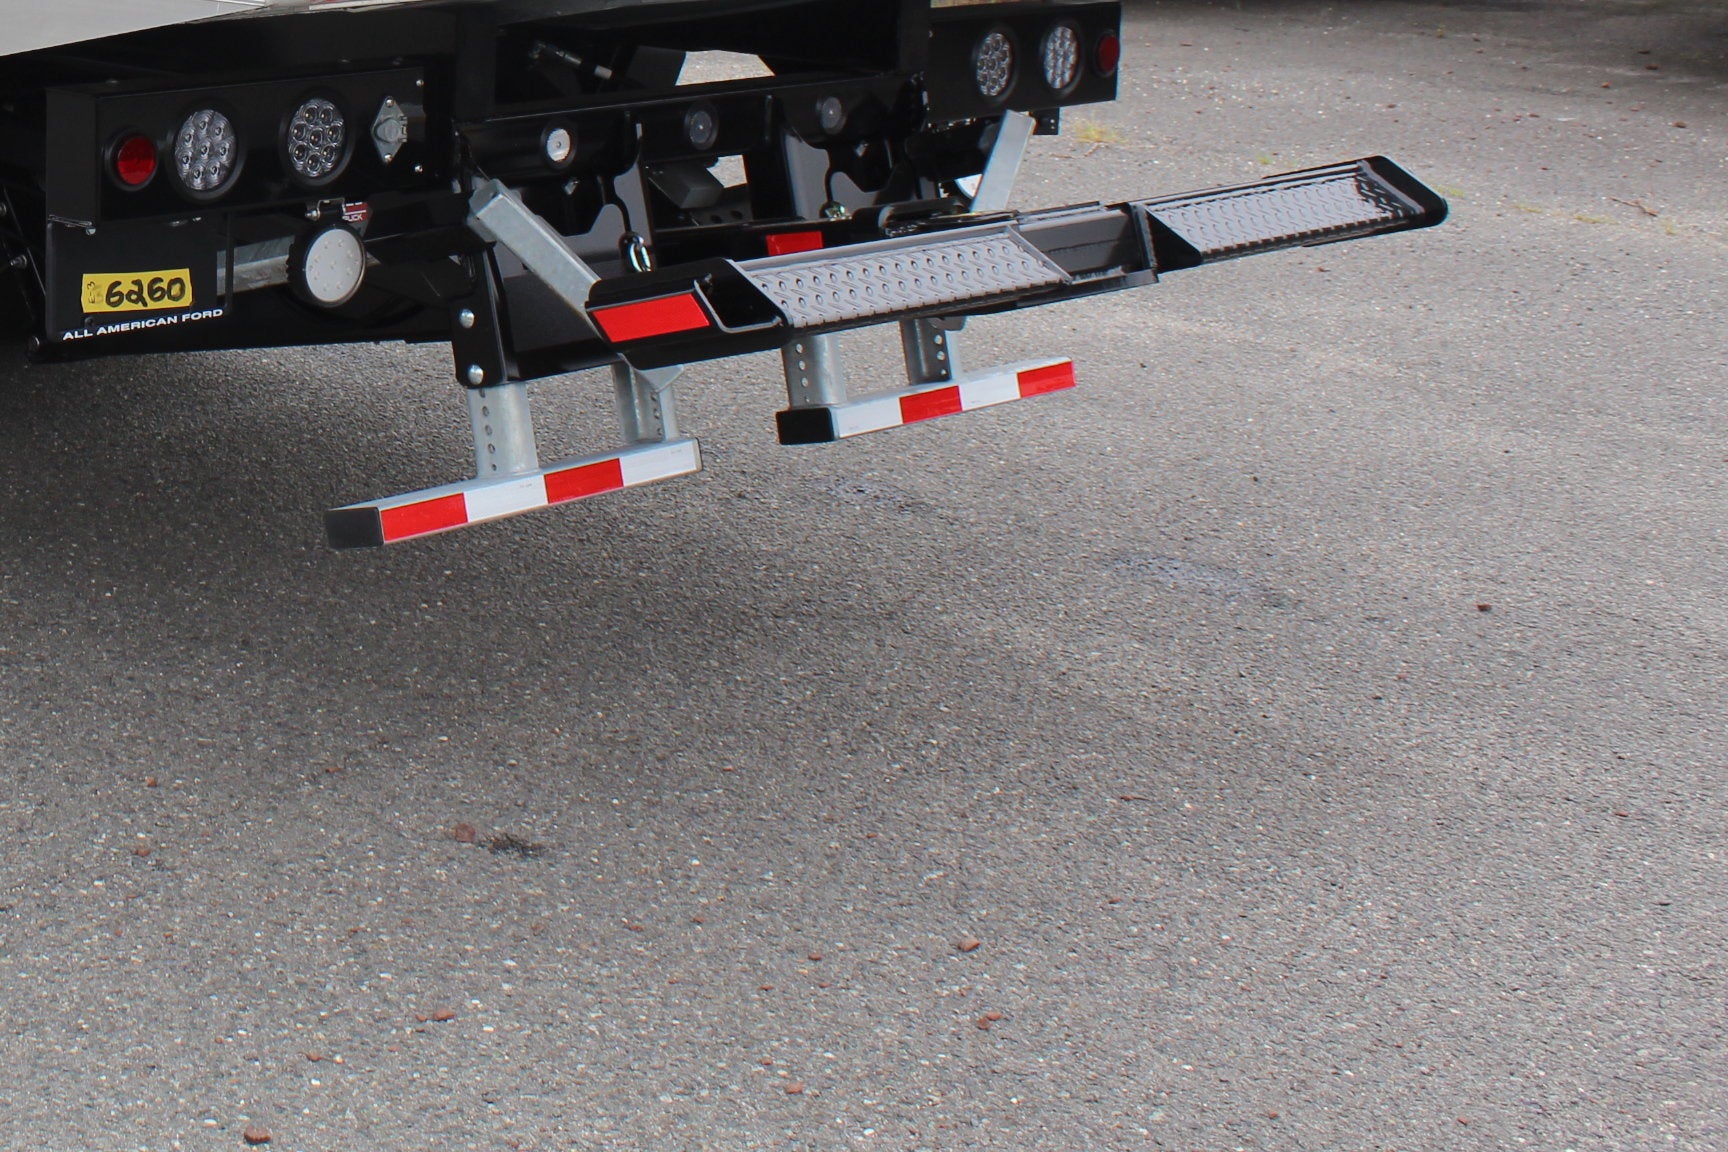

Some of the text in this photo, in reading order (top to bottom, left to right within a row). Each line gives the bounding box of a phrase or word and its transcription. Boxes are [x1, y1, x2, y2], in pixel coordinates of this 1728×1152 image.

[105, 276, 187, 309] 6260
[62, 308, 224, 341] ALL AMERICAN FORD
